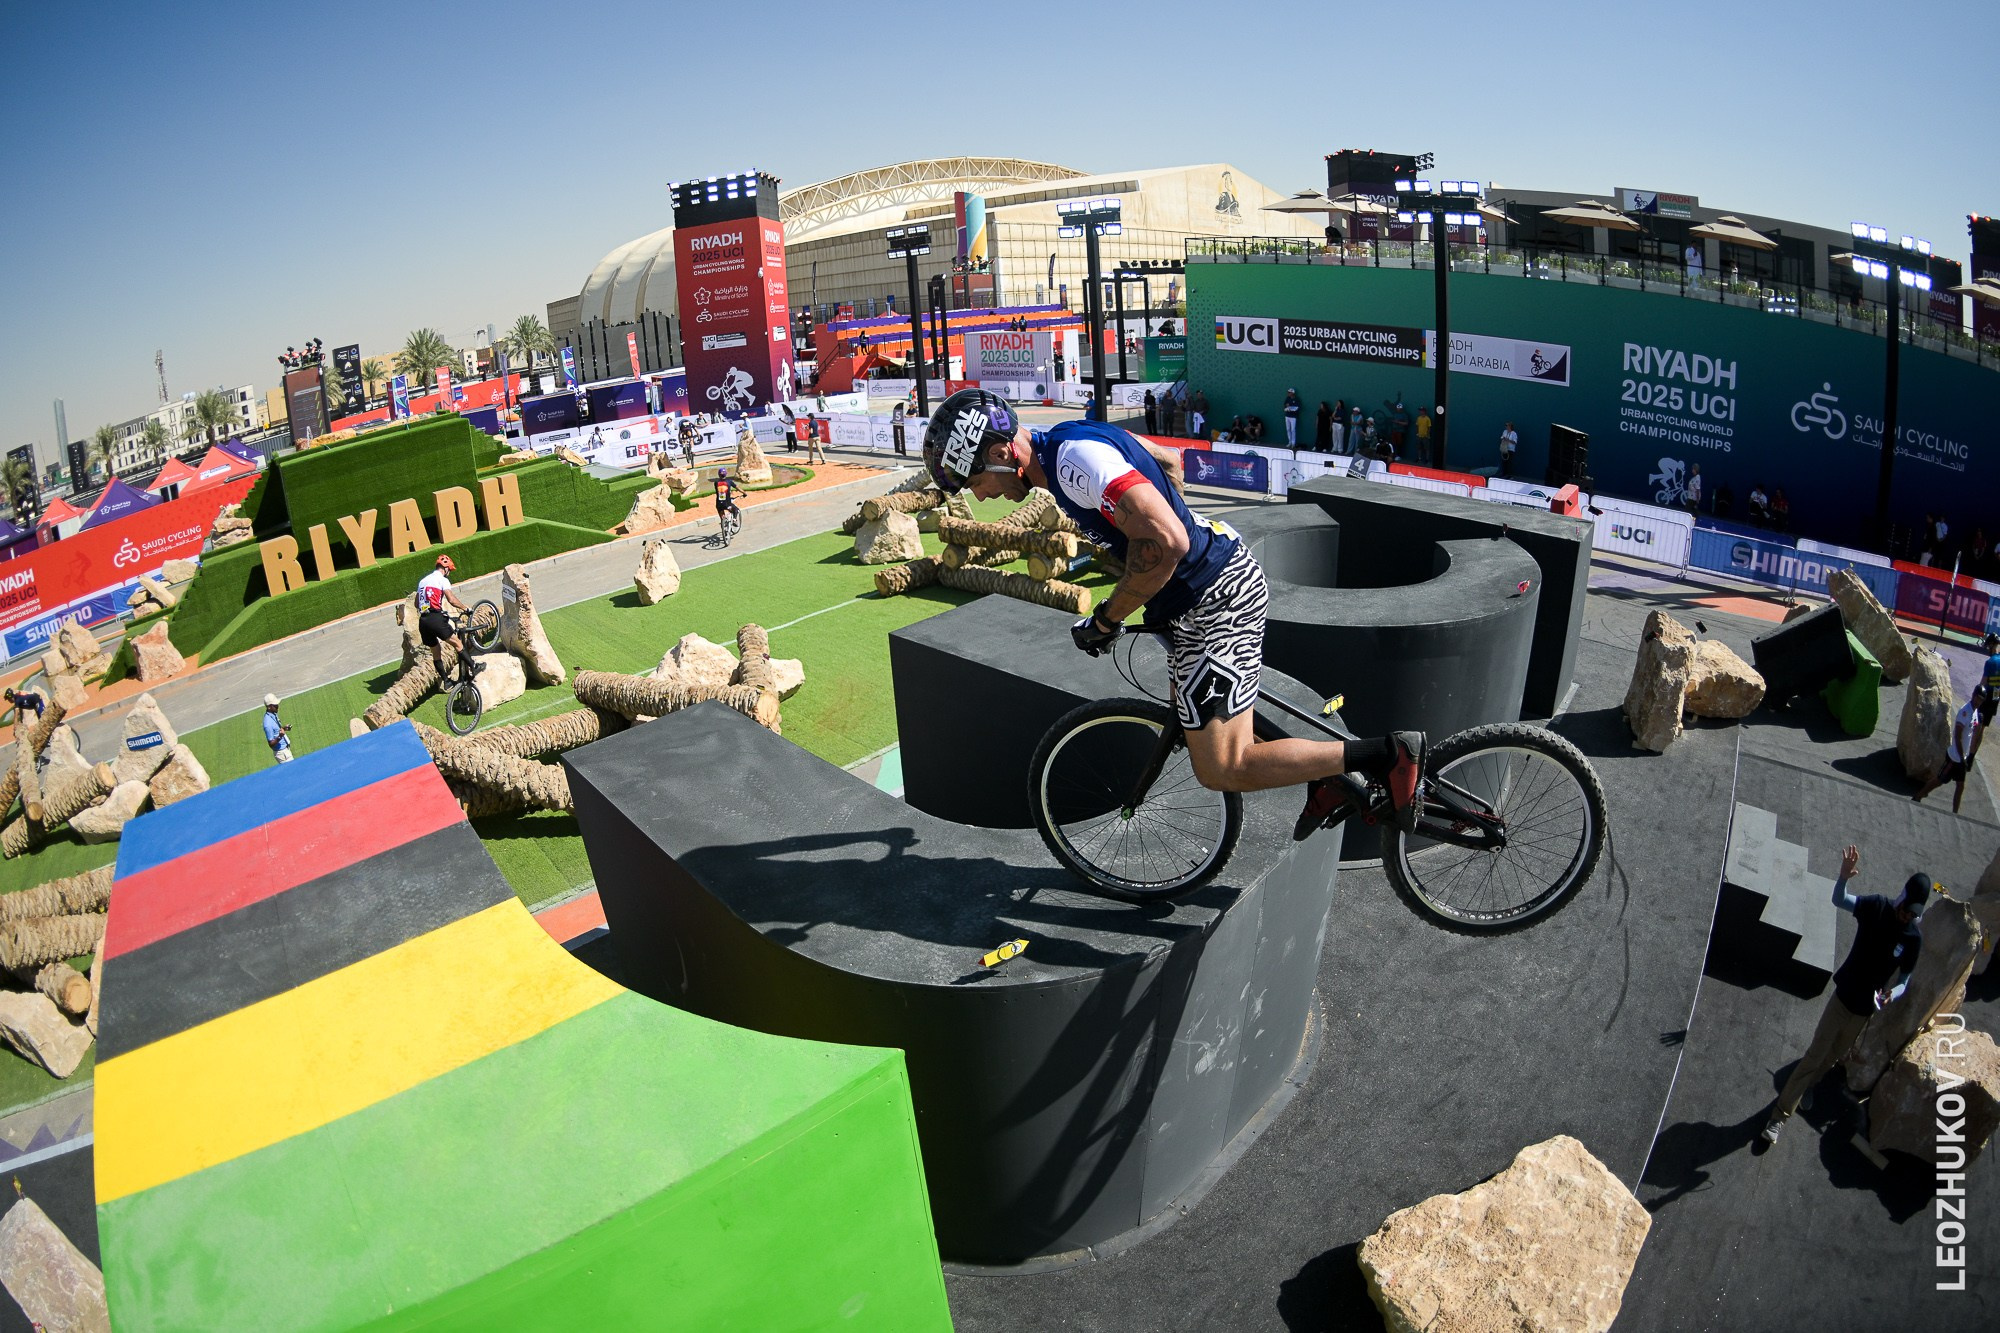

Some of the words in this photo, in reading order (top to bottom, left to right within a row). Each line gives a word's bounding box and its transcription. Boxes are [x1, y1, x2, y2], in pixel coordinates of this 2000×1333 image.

[691, 231, 743, 251] RIYADH
[692, 250, 720, 263] 2025
[723, 246, 744, 258] UCI
[693, 264, 745, 276] CHAMPIONSHIPS
[981, 333, 1033, 350] RIYADH
[1226, 322, 1274, 347] UCI
[1284, 325, 1307, 337] 2025
[1309, 326, 1346, 340] URBAN
[1348, 330, 1397, 344] CYCLING
[1432, 337, 1473, 352] RADH
[981, 350, 1010, 363] 2025
[1012, 350, 1035, 363] UCI
[1158, 342, 1185, 350] RIYADH
[1284, 338, 1323, 351] WORLD
[1325, 341, 1420, 361] CHAMPIONSHIPS
[1432, 350, 1466, 367] SUDI
[1470, 356, 1511, 372] ARABIA
[1623, 342, 1737, 390] RIYADH
[1621, 379, 1684, 411] 2025
[1690, 390, 1736, 421] UCI
[895, 411, 901, 421] 5
[1620, 407, 1655, 421] URBAN
[1655, 413, 1698, 429] CYCLING
[1698, 422, 1734, 437] WORLD
[651, 431, 715, 453] TISOT
[941, 407, 977, 470] TRIAL
[955, 410, 989, 478] BIKES
[1619, 421, 1732, 453] CHAMPIONSHIPS
[1854, 414, 1902, 440] SAUI
[1906, 428, 1969, 459] CYCLING
[1354, 459, 1365, 471] 4
[141, 537, 167, 551] SAUDI
[167, 525, 202, 542] CYCLING
[259, 473, 526, 598] RIYADH
[1618, 524, 1652, 545] UCI
[1731, 545, 1838, 585] SHIMAN
[19, 585, 38, 601] UCI
[128, 735, 162, 747] SHIMANO
